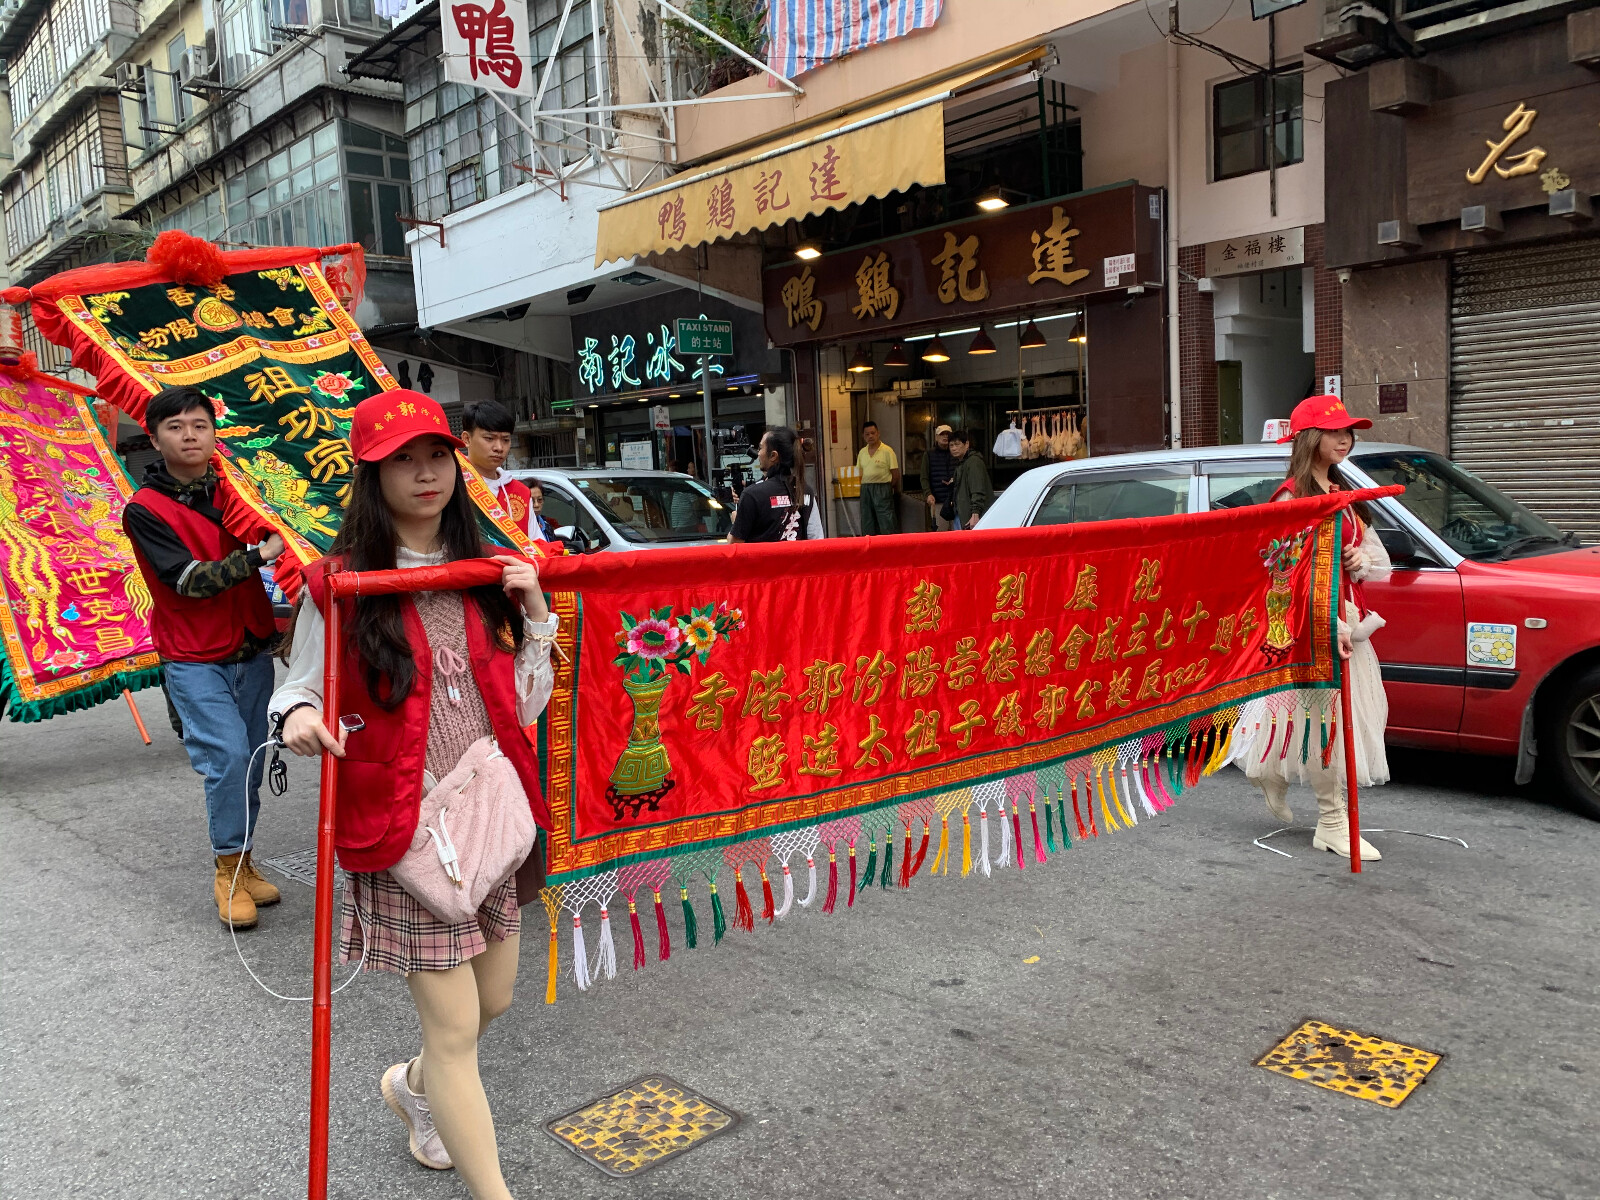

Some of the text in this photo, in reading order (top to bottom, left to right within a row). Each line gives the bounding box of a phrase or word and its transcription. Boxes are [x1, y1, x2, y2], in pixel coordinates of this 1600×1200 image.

[451, 0, 523, 89] 鴨
[1465, 101, 1548, 185] 名
[1222, 234, 1287, 261] 金福樓
[679, 322, 730, 334] TAXI STAND
[691, 336, 722, 349] 的士站
